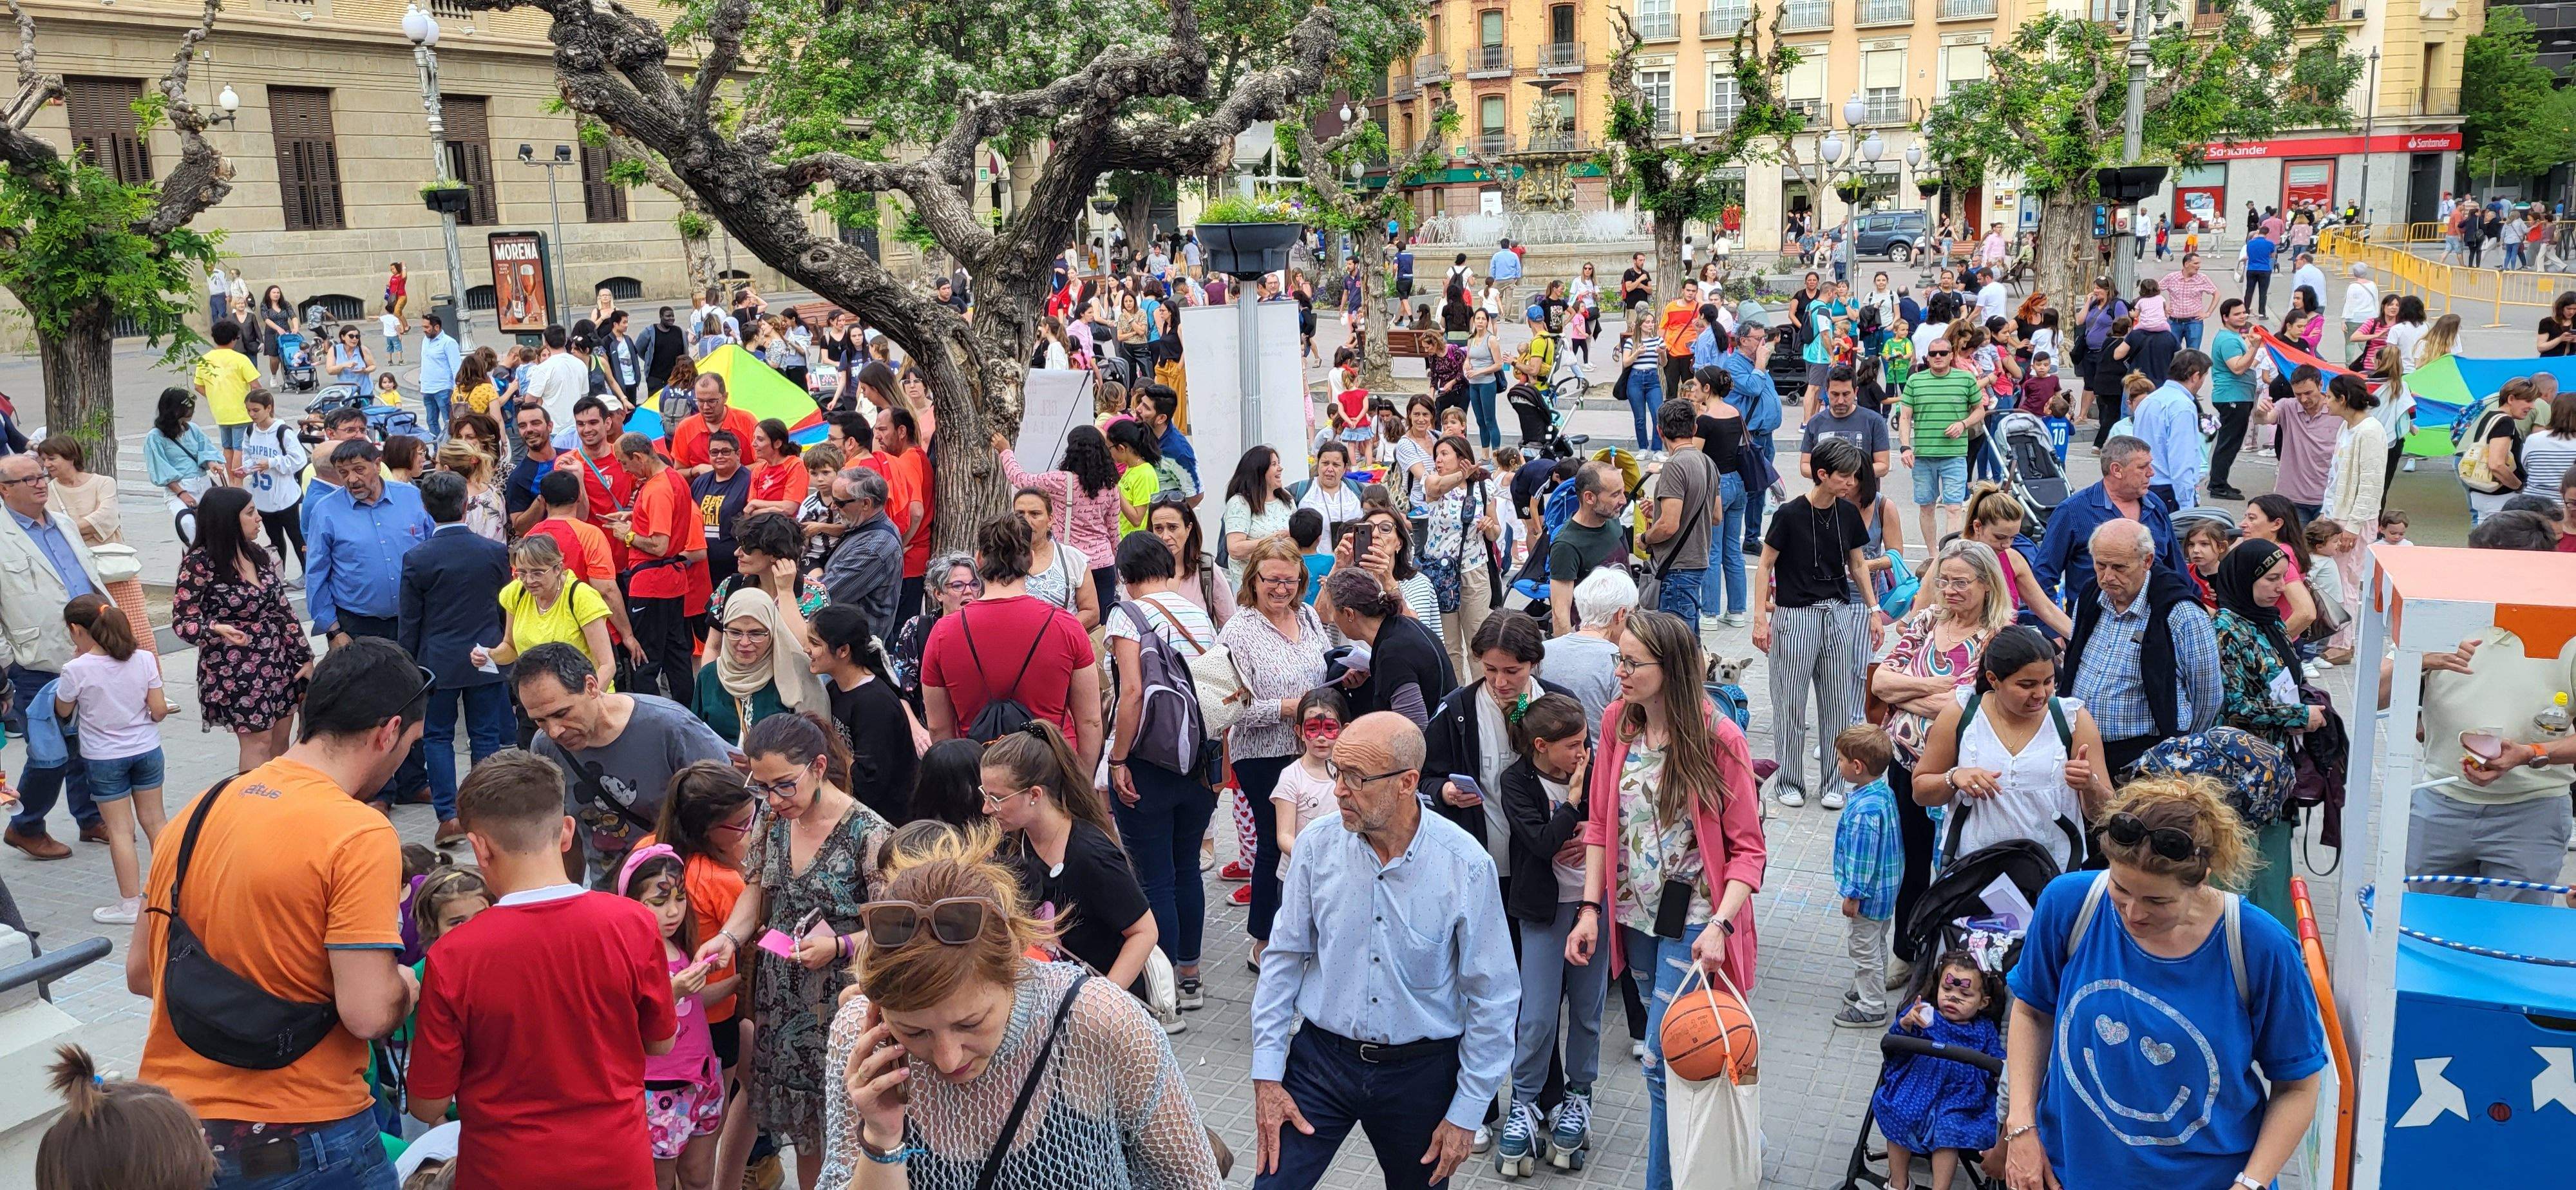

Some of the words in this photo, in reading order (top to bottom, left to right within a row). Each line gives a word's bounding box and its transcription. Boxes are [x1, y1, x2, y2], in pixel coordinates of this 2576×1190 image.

[2416, 138, 2450, 148] Santander
[494, 242, 539, 260] MORENA
[2052, 428, 2066, 446] 10
